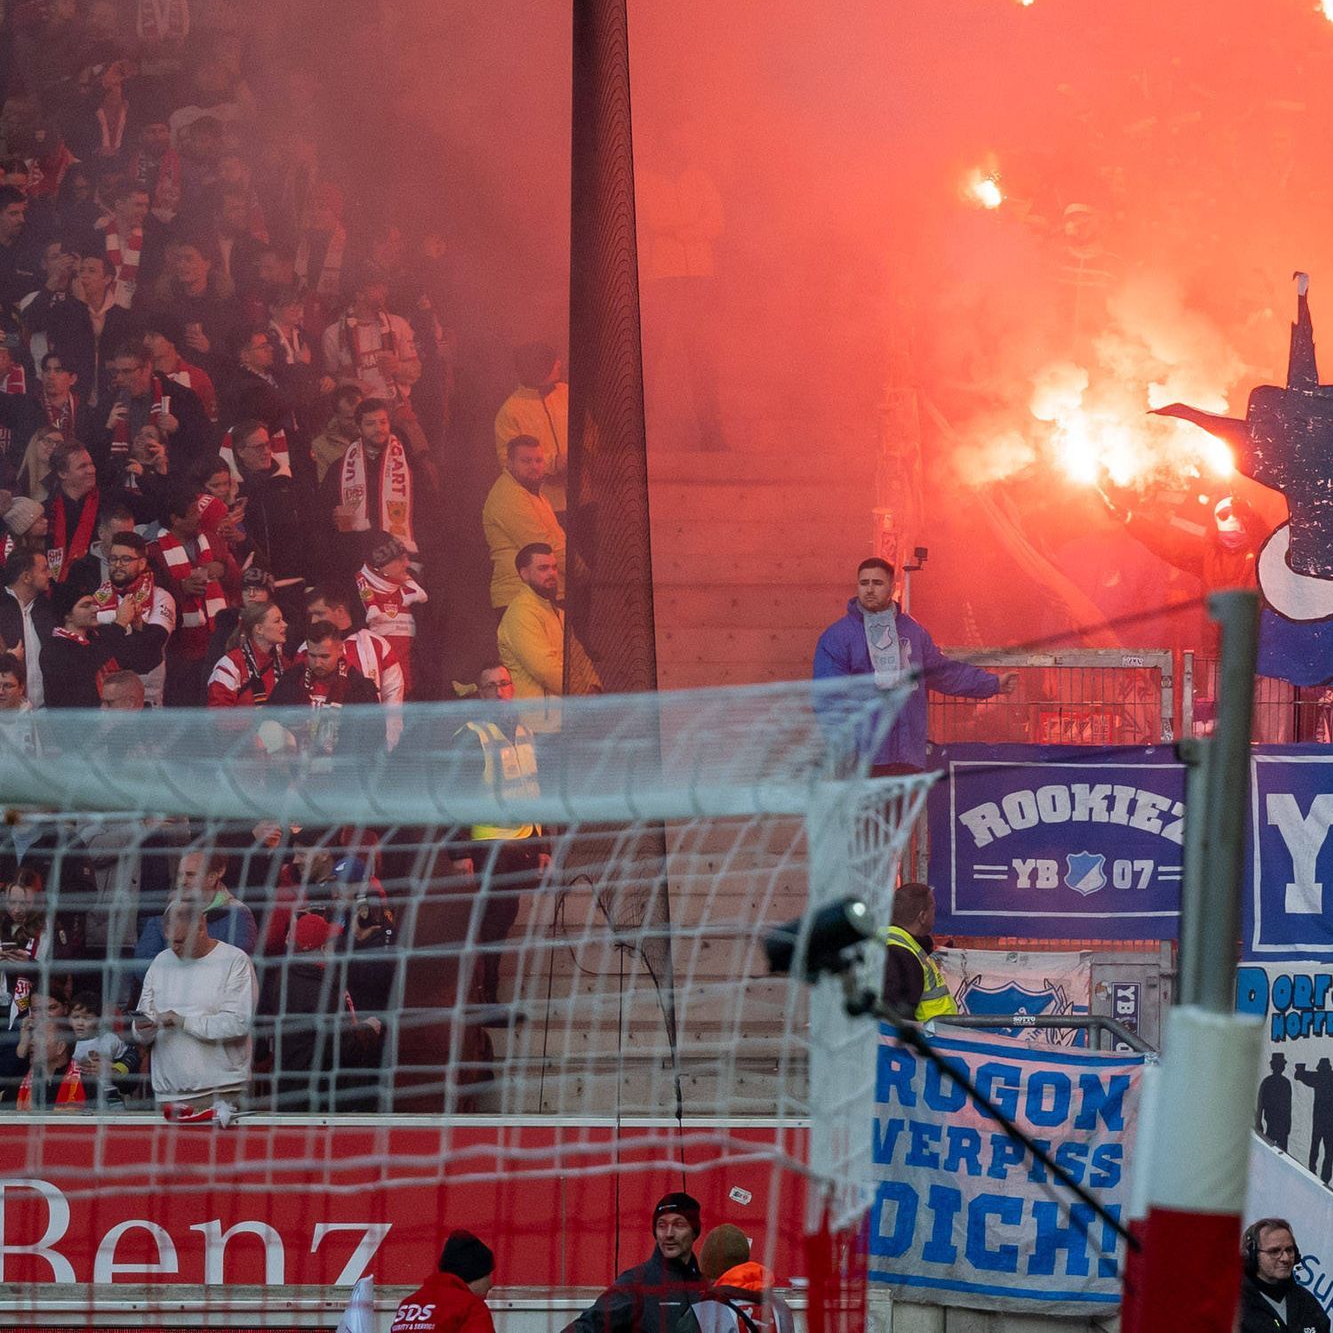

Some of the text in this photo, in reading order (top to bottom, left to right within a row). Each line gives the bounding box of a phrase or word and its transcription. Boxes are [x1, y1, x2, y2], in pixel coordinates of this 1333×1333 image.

[958, 783, 1186, 849] ROOKIEZ
[1012, 858, 1154, 889] YB 07
[1117, 987, 1136, 1015] YB
[875, 1044, 1131, 1132] ROGON
[872, 1117, 1124, 1189] VERPISS
[0, 1177, 394, 1286] Benz
[394, 1303, 436, 1323] SDS
